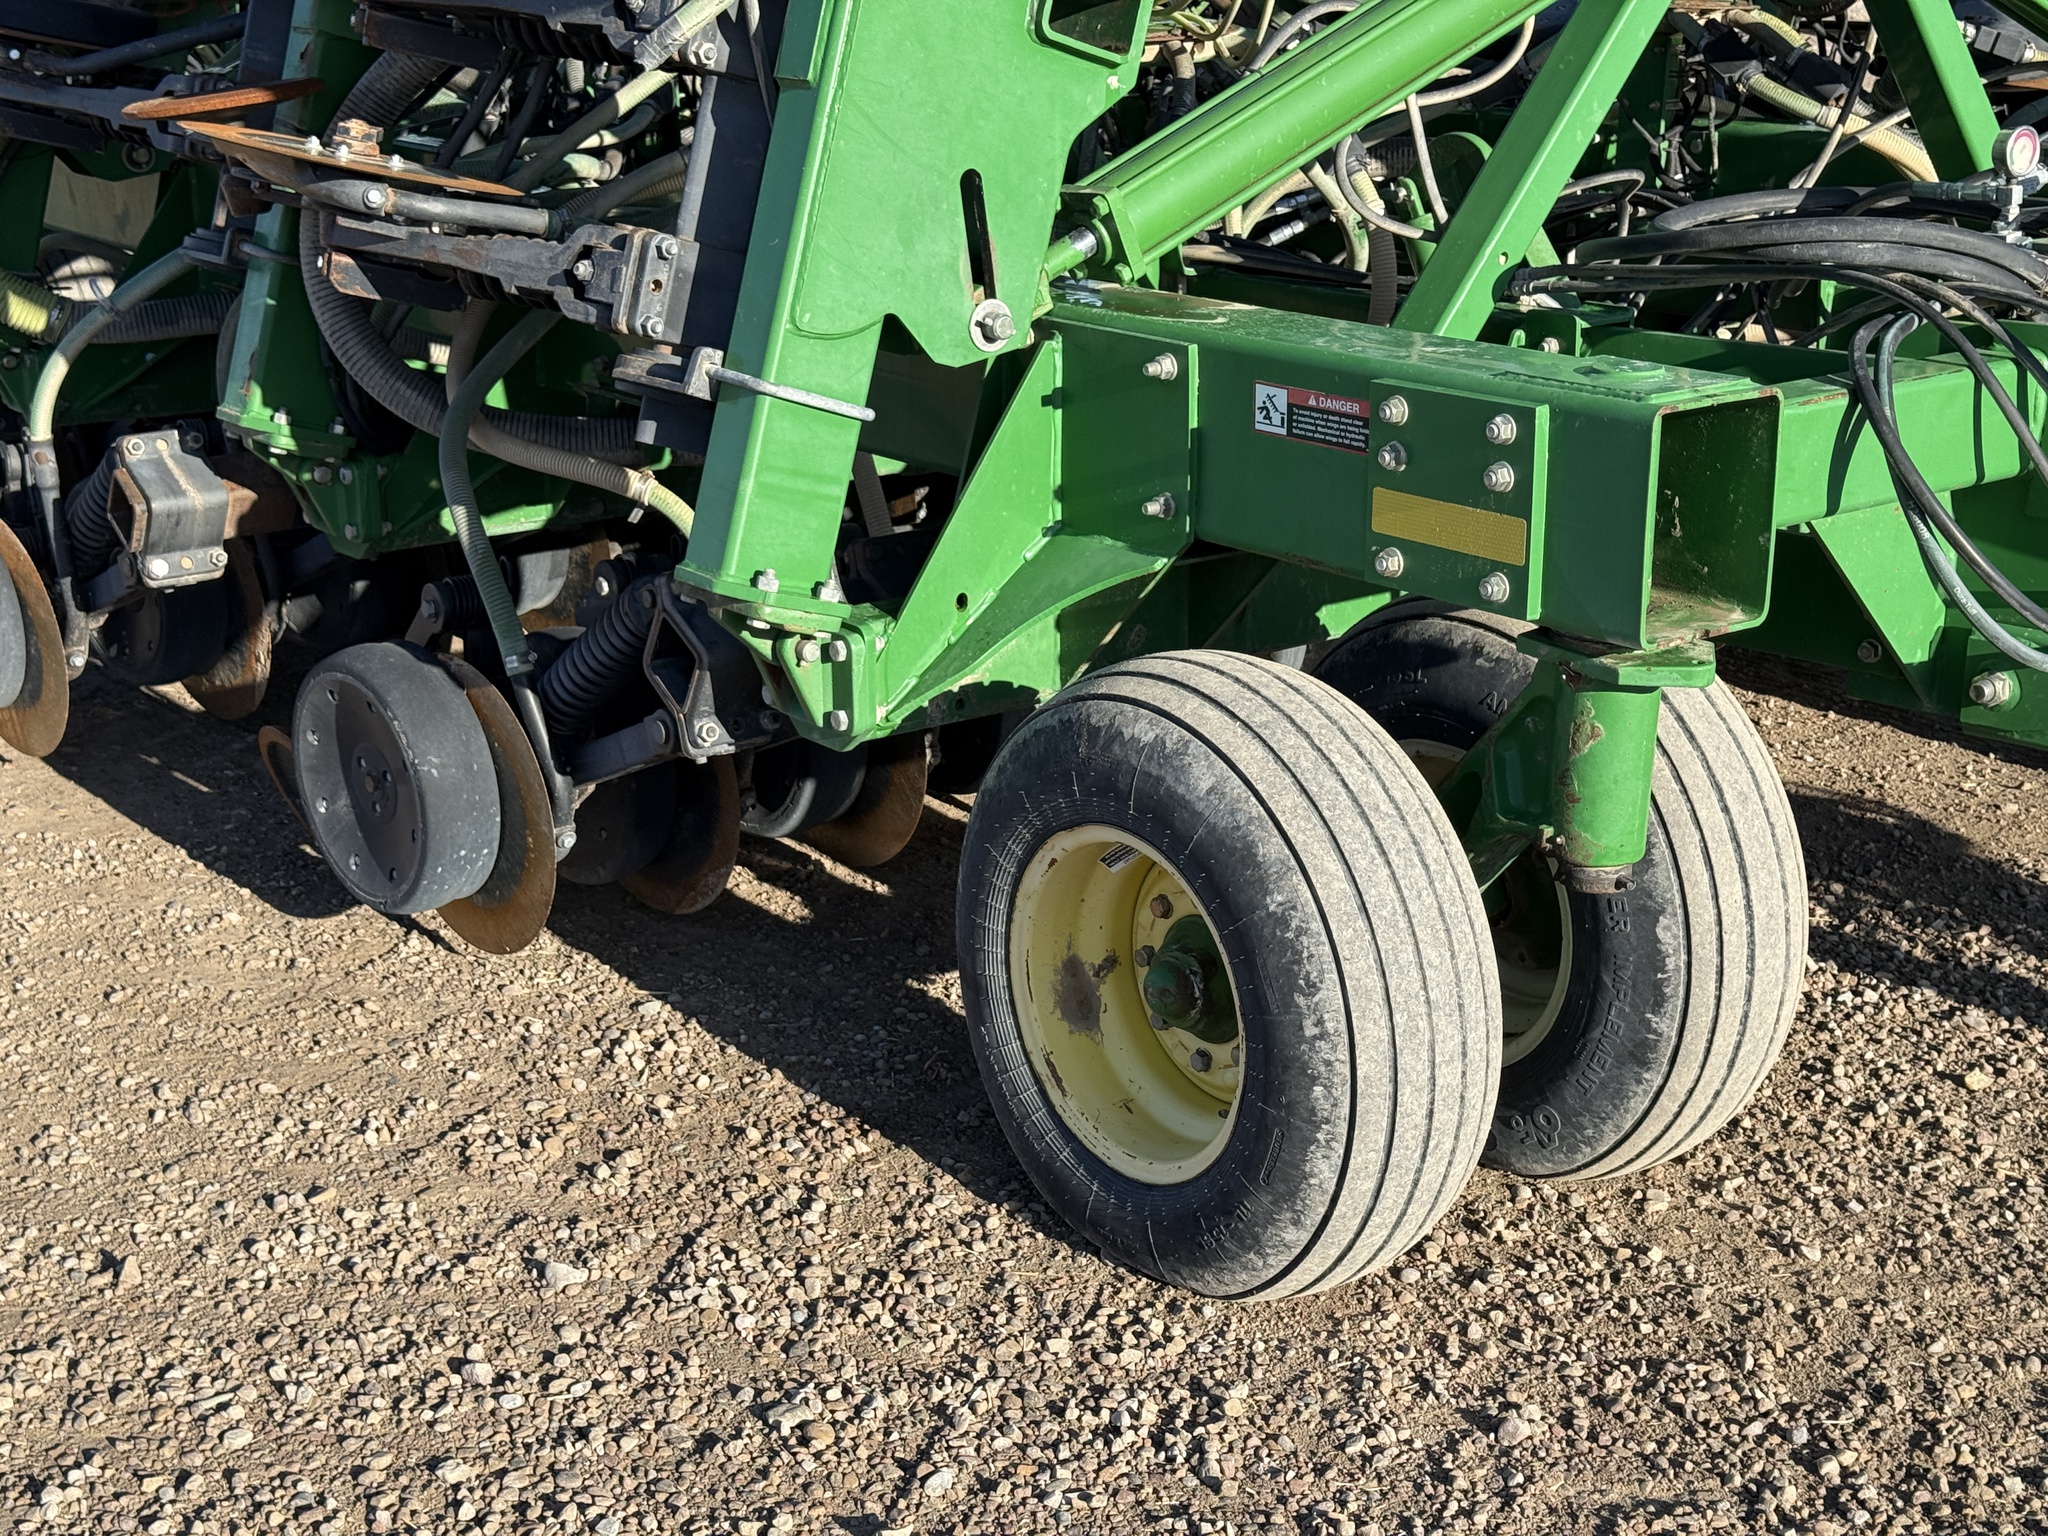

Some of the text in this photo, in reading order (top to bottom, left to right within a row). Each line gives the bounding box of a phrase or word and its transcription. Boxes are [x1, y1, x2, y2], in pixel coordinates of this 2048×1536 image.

[1320, 397, 1359, 414] DANGER
[1311, 411, 1322, 419] injury
[1317, 426, 1340, 435] Mechanical
[1346, 432, 1365, 440] hydraulic
[1953, 586, 1978, 616] Dura-Tuff
[1576, 953, 1633, 1096] IMPLEMENT
